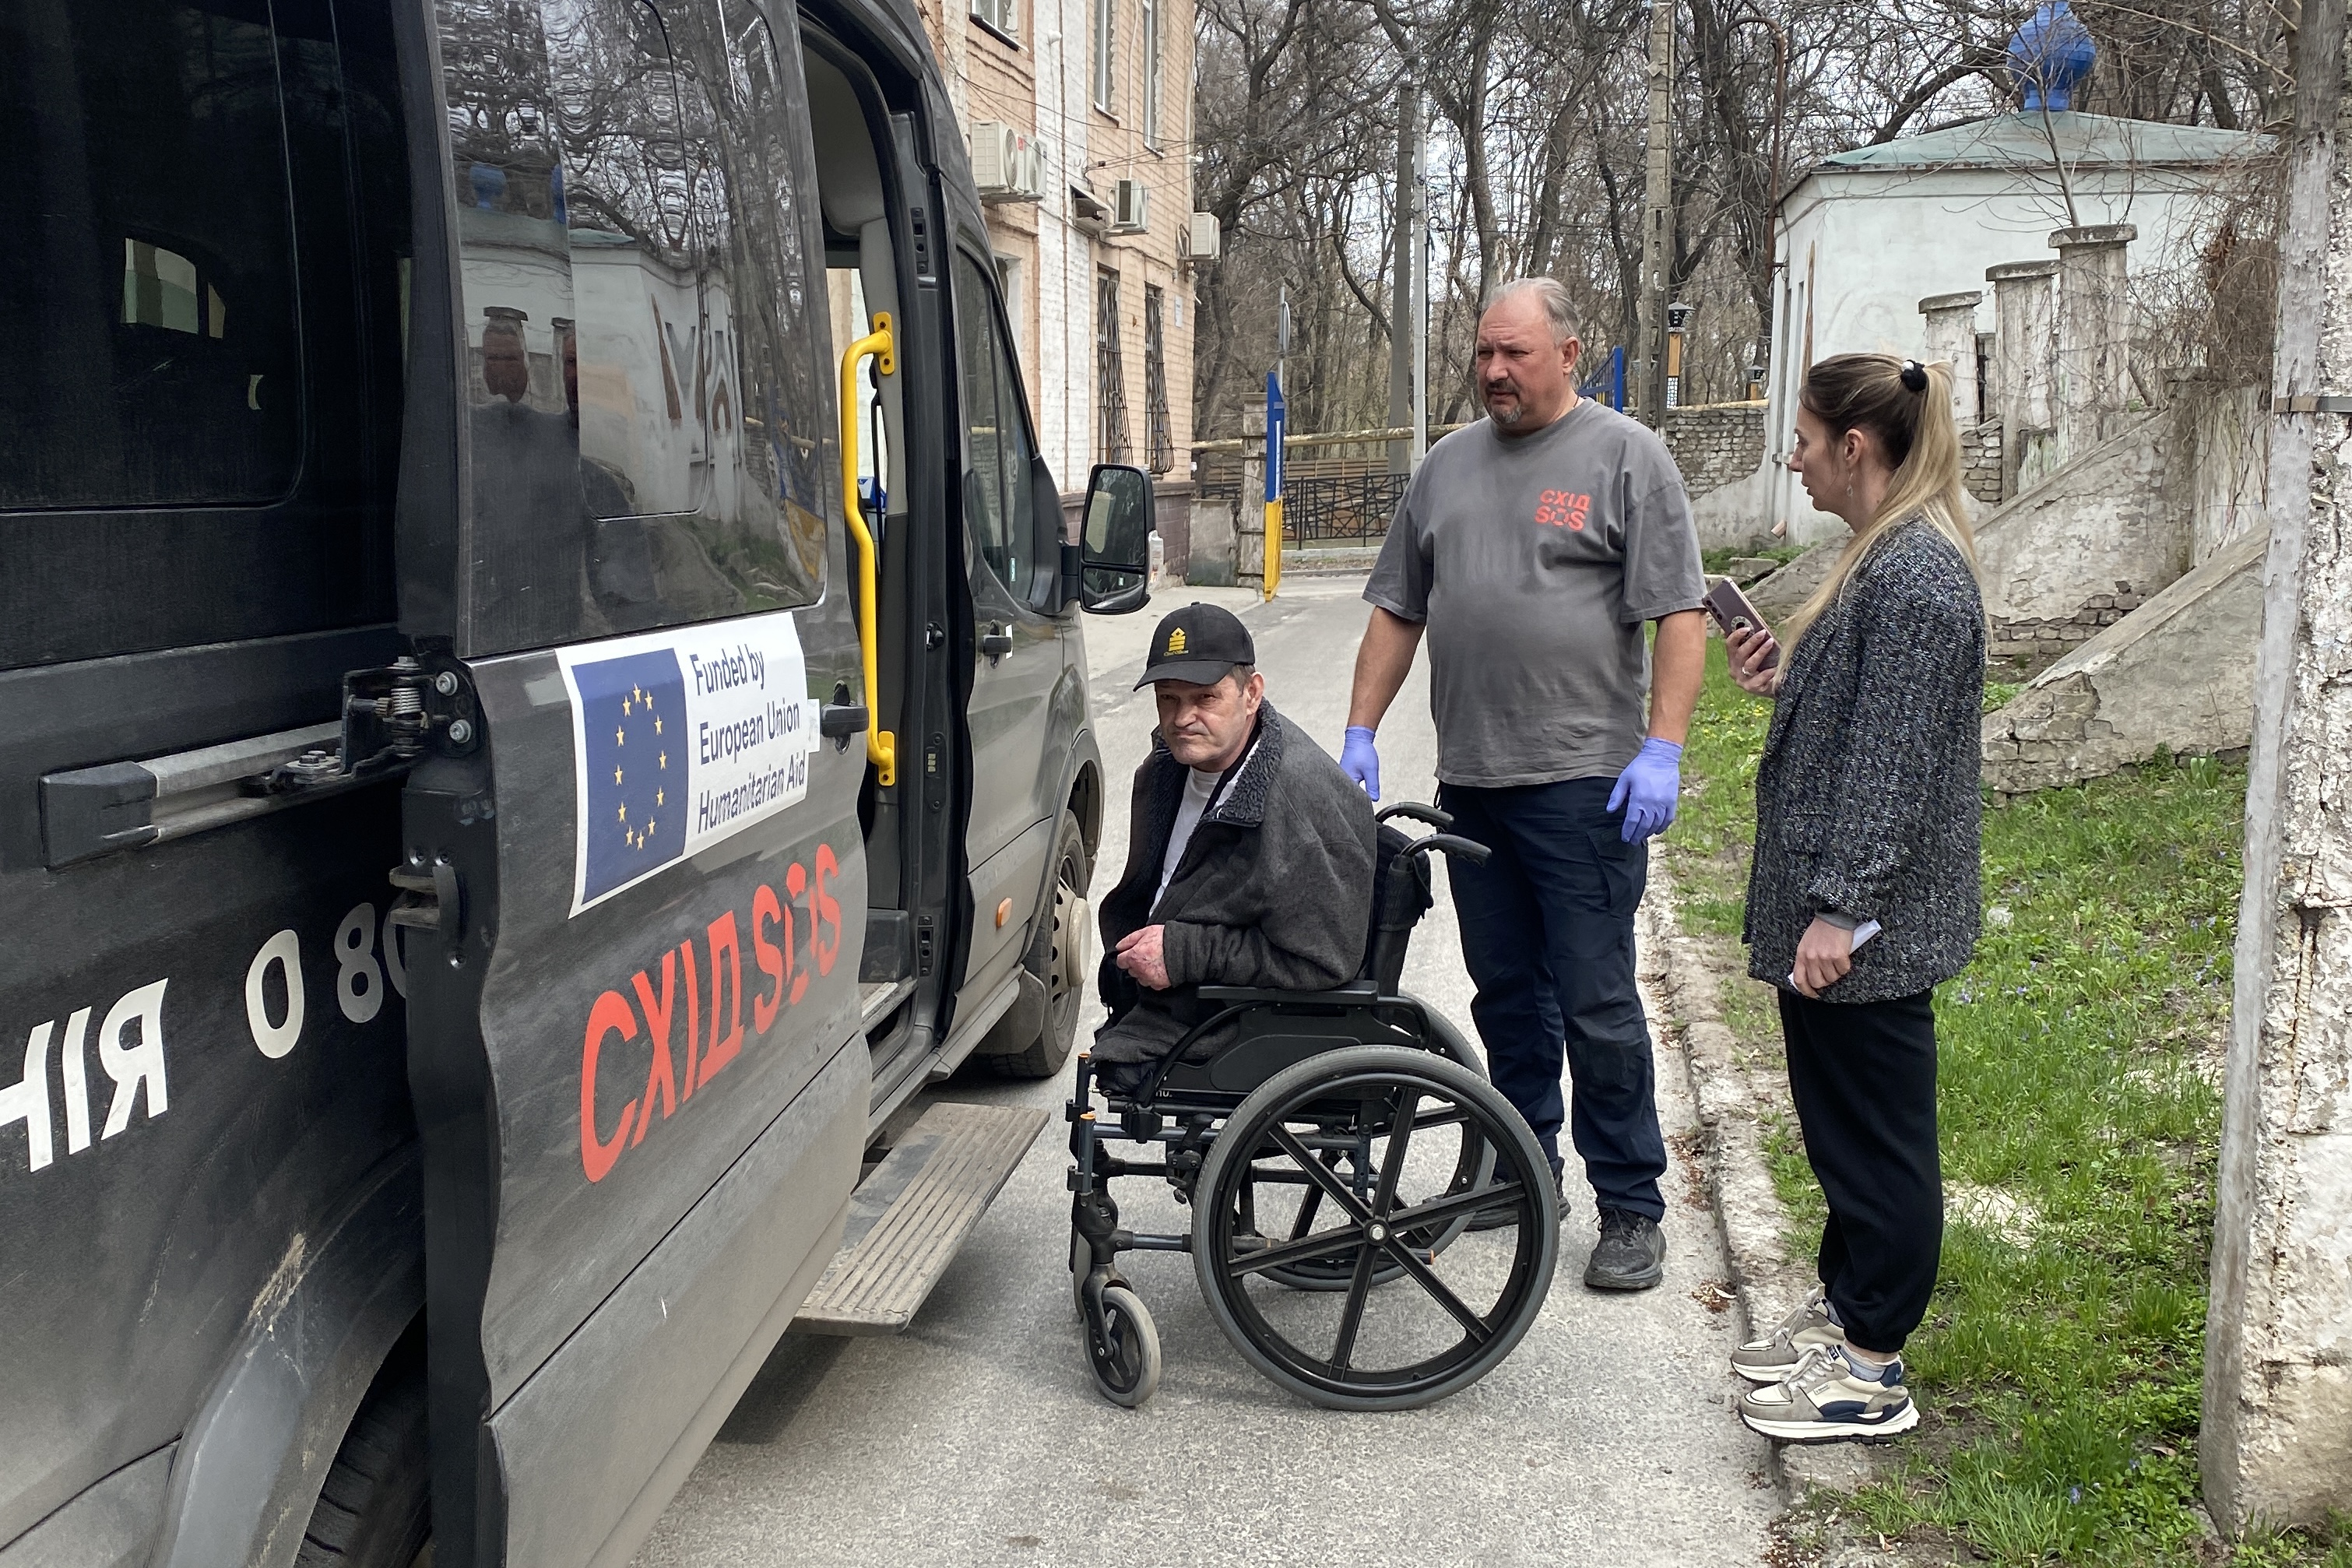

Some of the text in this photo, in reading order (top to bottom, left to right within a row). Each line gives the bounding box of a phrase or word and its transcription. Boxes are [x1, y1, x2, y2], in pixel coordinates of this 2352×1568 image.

[1535, 505, 1586, 531] SOS
[1540, 489, 1591, 512] СХІД
[689, 643, 765, 696] Funded by
[700, 698, 800, 765] European Union
[698, 749, 806, 834] Humanitarian Aid
[245, 929, 305, 1059] 0
[581, 843, 842, 1183] СХІД SOS
